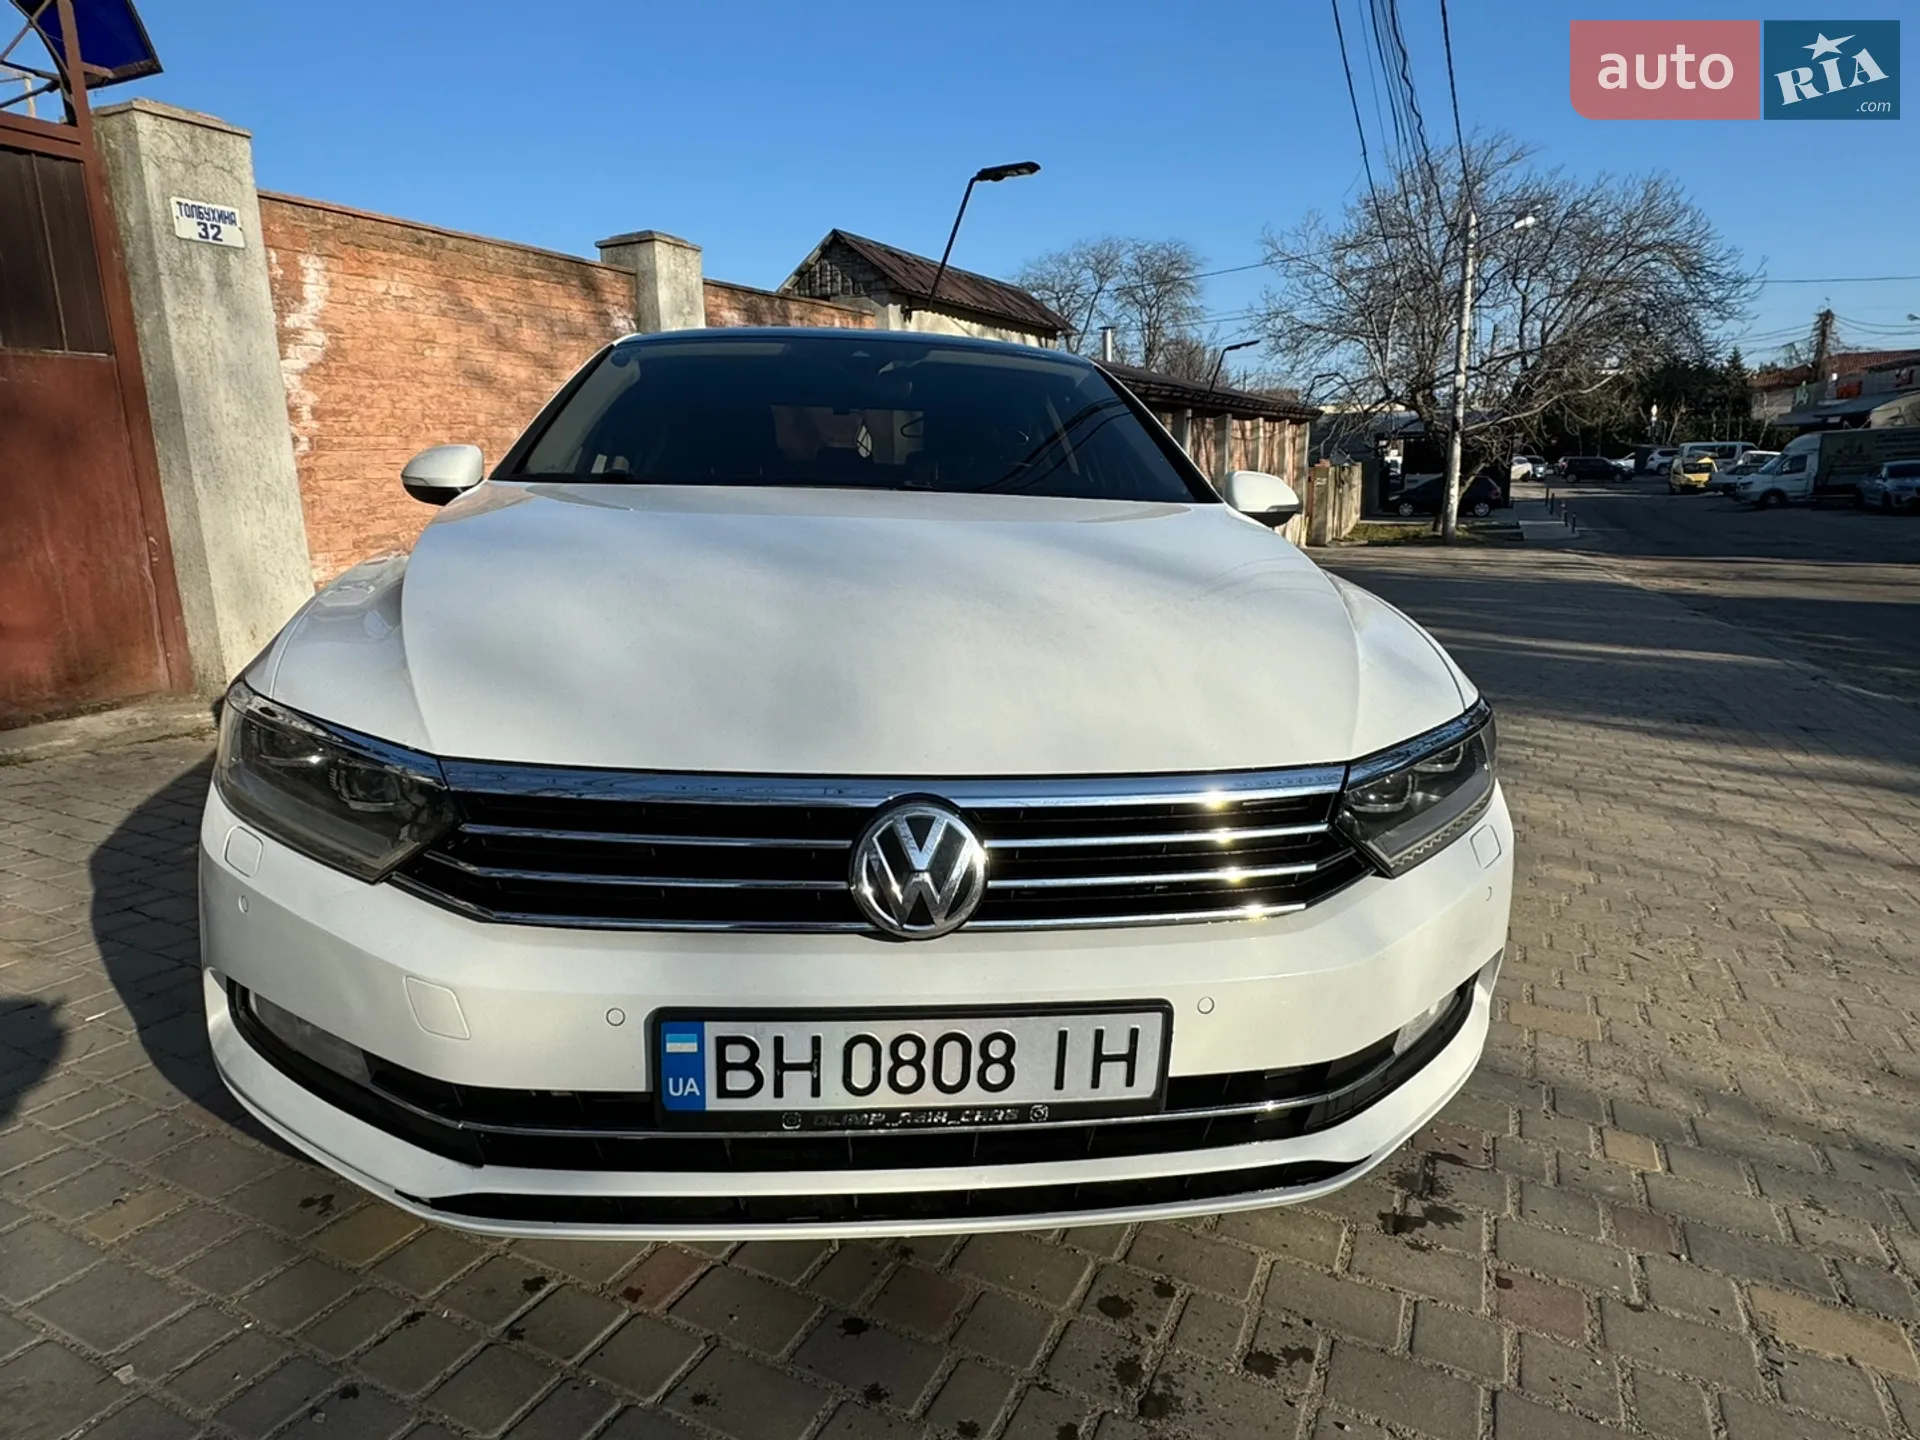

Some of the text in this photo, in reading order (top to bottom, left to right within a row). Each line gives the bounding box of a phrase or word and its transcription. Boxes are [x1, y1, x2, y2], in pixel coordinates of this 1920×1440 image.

[176, 201, 238, 226] ТОЛБУХИНА
[196, 221, 224, 242] 32
[860, 811, 981, 934] VW
[715, 1026, 1140, 1099] BH 0808 IH
[668, 1077, 700, 1097] UA
